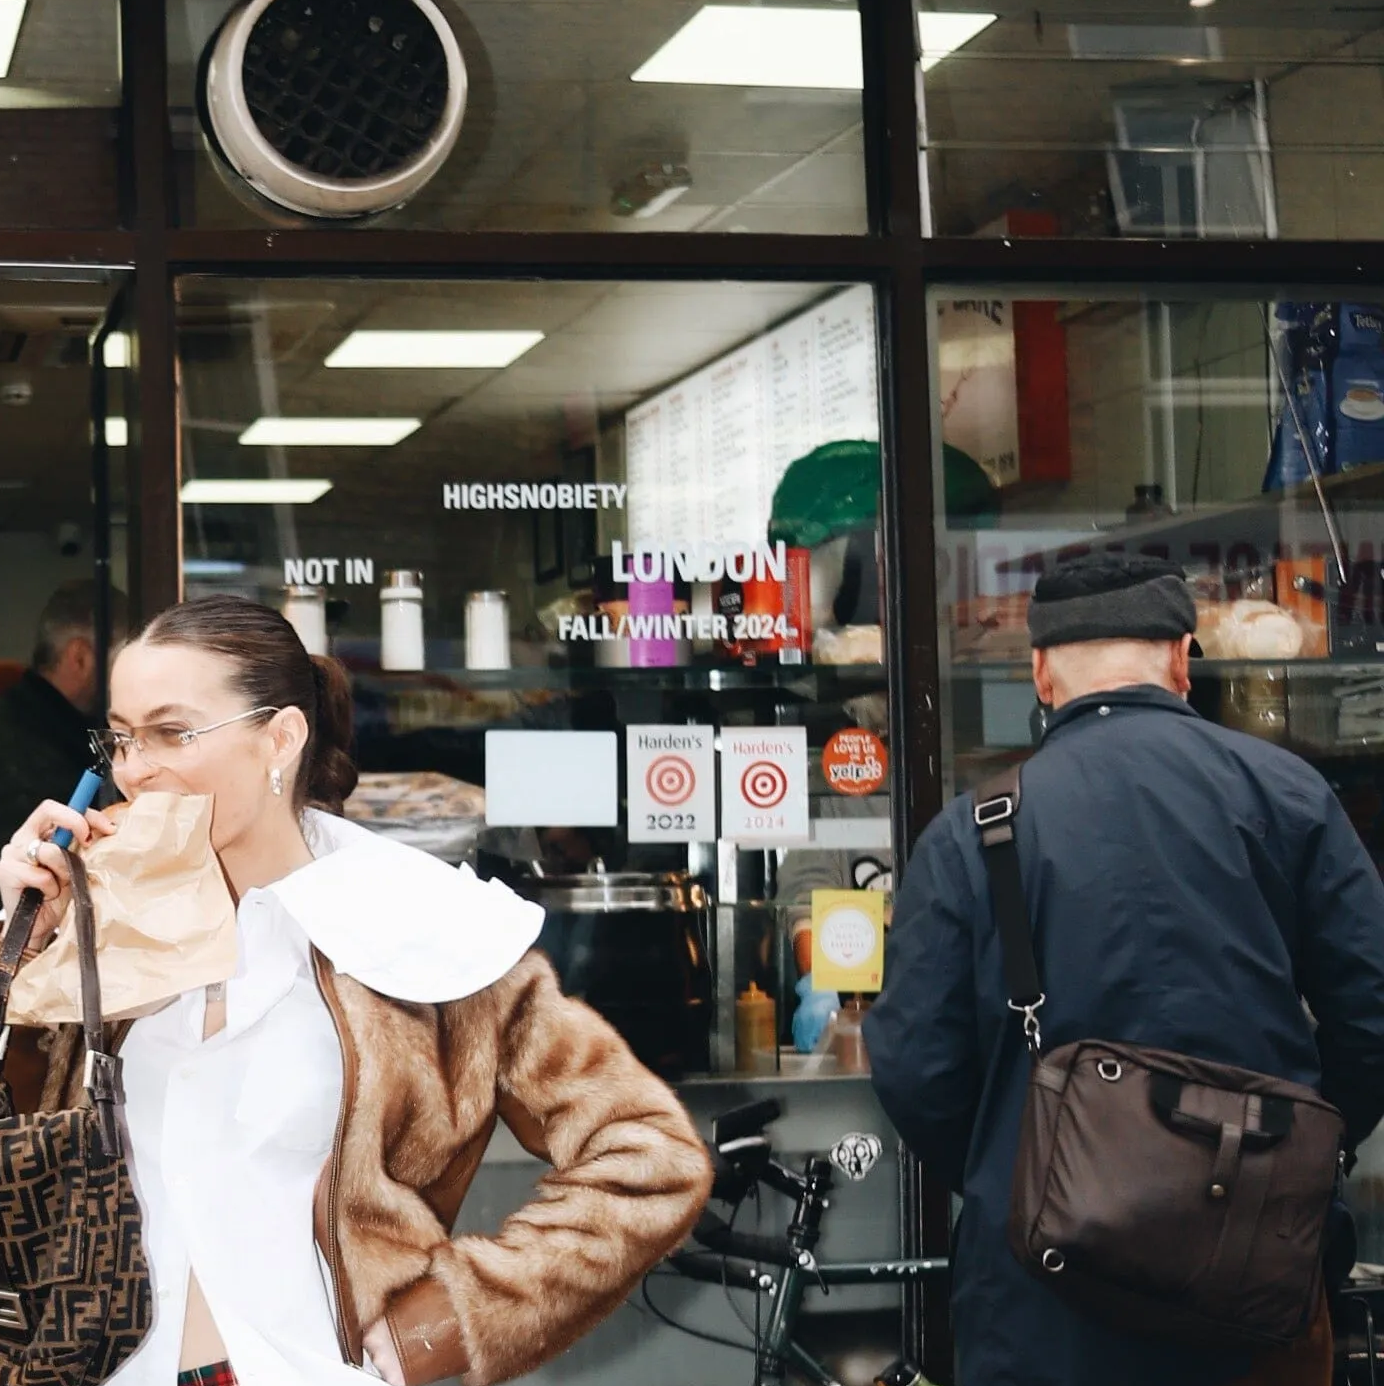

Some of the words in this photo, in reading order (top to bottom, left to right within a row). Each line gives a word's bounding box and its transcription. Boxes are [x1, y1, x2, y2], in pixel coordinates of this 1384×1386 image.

[442, 482, 627, 510] HIGHSNOBIETY
[283, 557, 338, 585] NOT
[344, 557, 374, 584] IN
[612, 539, 787, 583] LONDON
[558, 613, 728, 641] FALL/WINTER
[638, 733, 703, 750] Harden's
[732, 740, 794, 754] Harden's
[833, 743, 860, 754] LOVE
[645, 813, 697, 831] 2022
